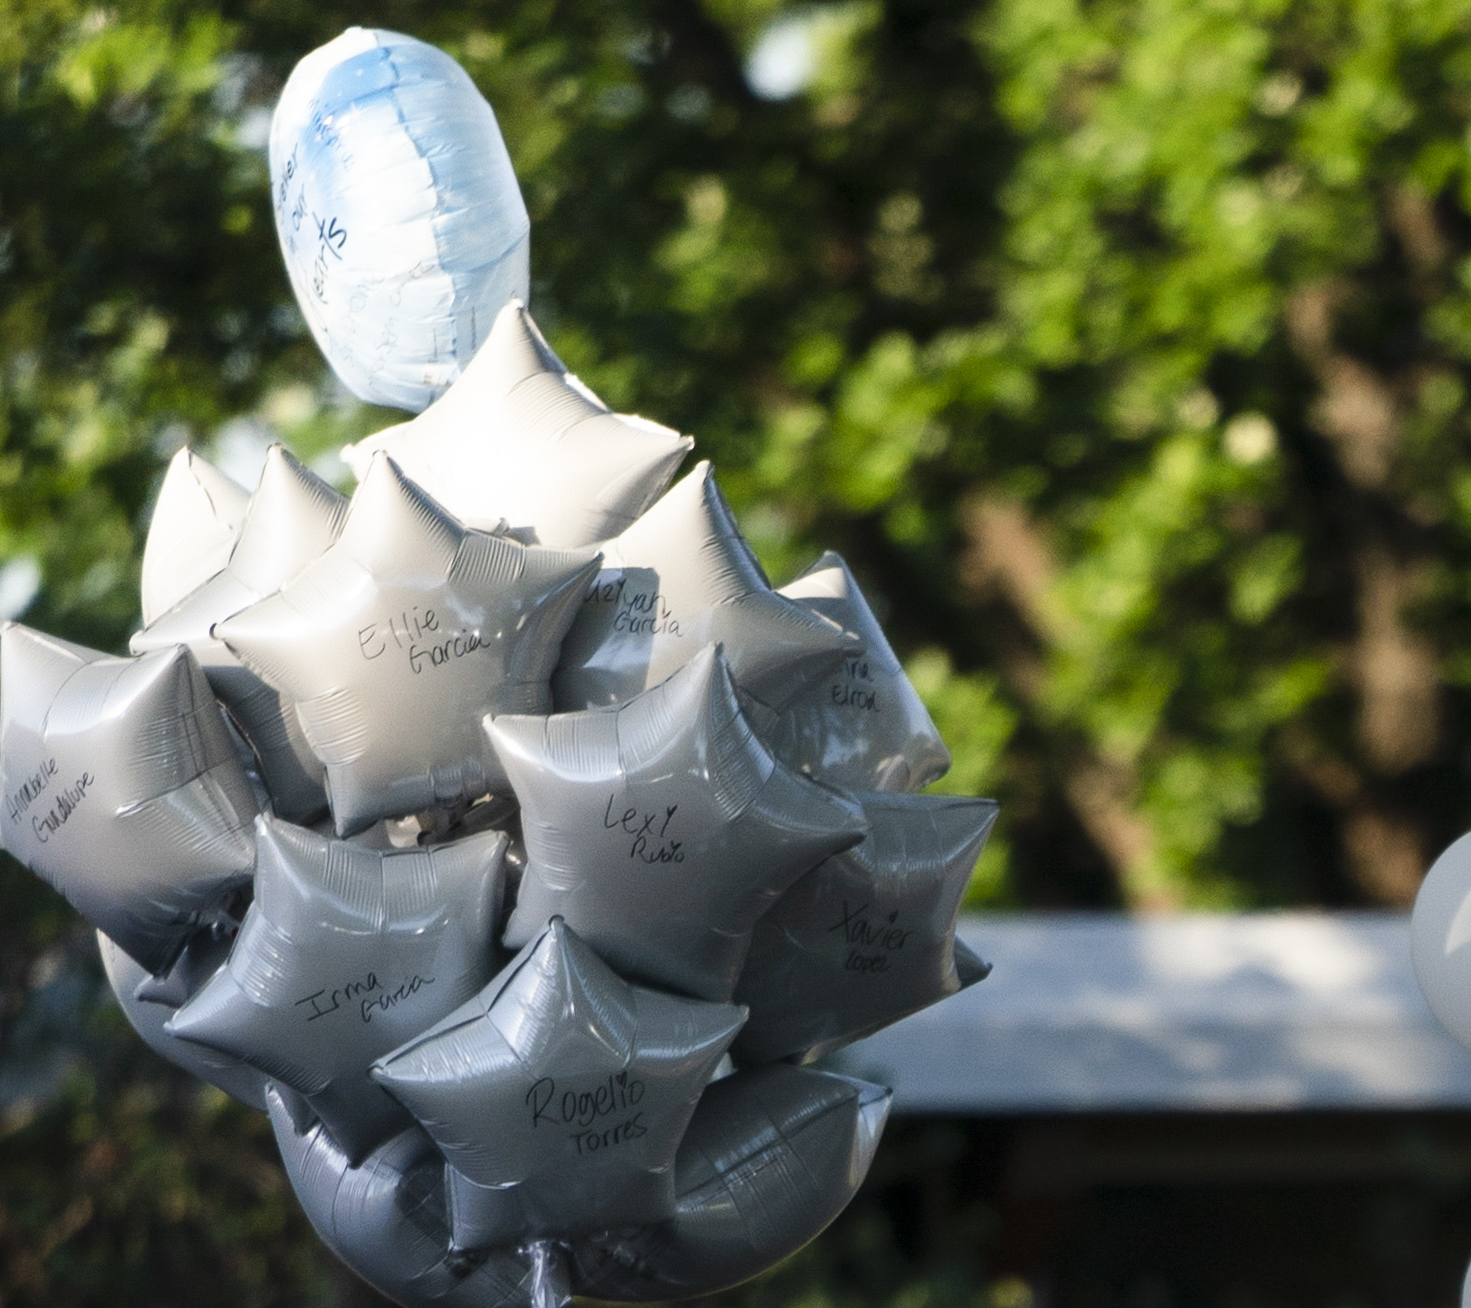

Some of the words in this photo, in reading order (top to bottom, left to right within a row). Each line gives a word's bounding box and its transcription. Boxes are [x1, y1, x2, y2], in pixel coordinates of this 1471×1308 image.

[313, 211, 347, 304] earts
[358, 606, 439, 660] Ellie
[409, 629, 490, 674] Garcia
[294, 972, 383, 1021] Irma
[526, 1071, 645, 1128] Rogelio
[570, 1112, 648, 1155] Torres
